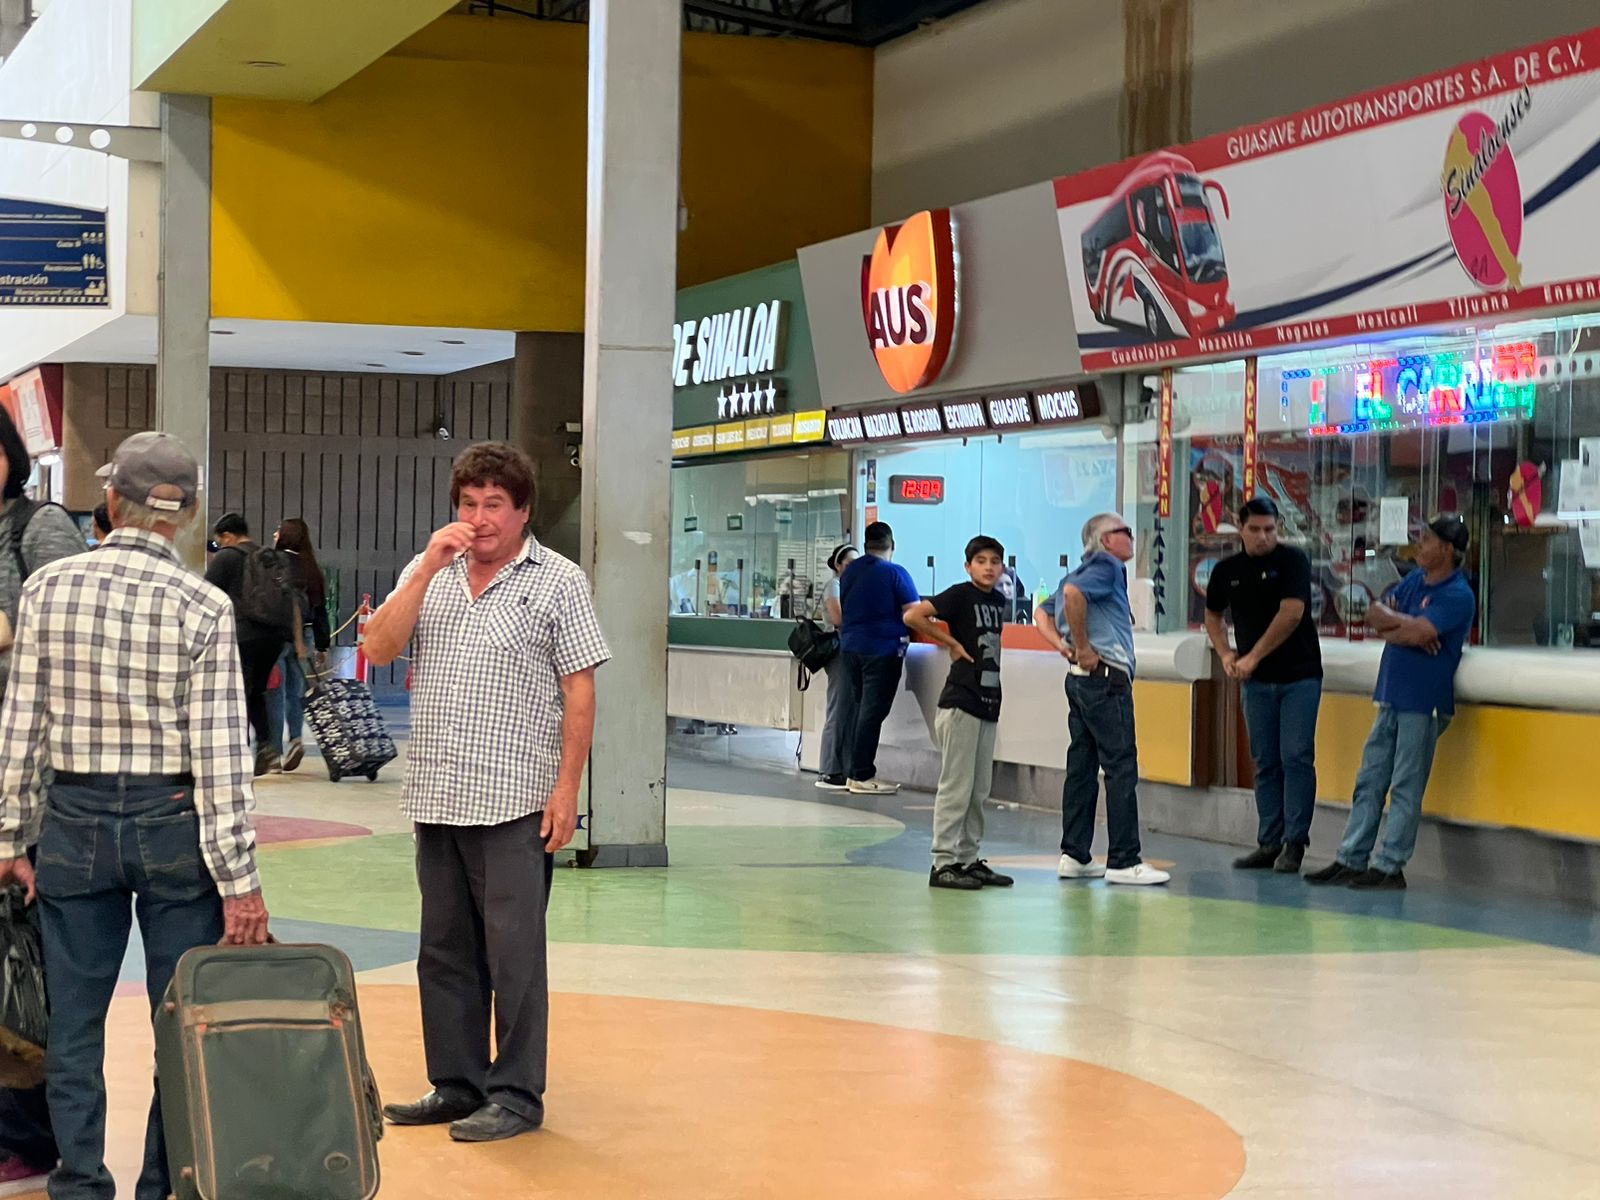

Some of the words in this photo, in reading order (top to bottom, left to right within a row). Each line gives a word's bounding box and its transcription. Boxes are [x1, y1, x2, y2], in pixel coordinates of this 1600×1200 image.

[1226, 120, 1296, 160] GUASAVE
[1300, 72, 1465, 141] AUTOTRANSPORTES
[1471, 64, 1508, 95] S.A.
[1514, 52, 1541, 84] DE
[1547, 40, 1585, 74] C.V.
[692, 299, 780, 385] SINALOA
[869, 284, 928, 350] AUS
[1111, 343, 1178, 365] Guadalajara
[1198, 330, 1253, 353] Mazatlán
[1276, 320, 1330, 343] Nogales
[1447, 293, 1510, 319] Tijuana
[989, 397, 1031, 425] GUASAVE
[1037, 389, 1079, 420] MOCHIS
[1160, 367, 1172, 516] MAZATLAN
[901, 479, 942, 500] 12:09
